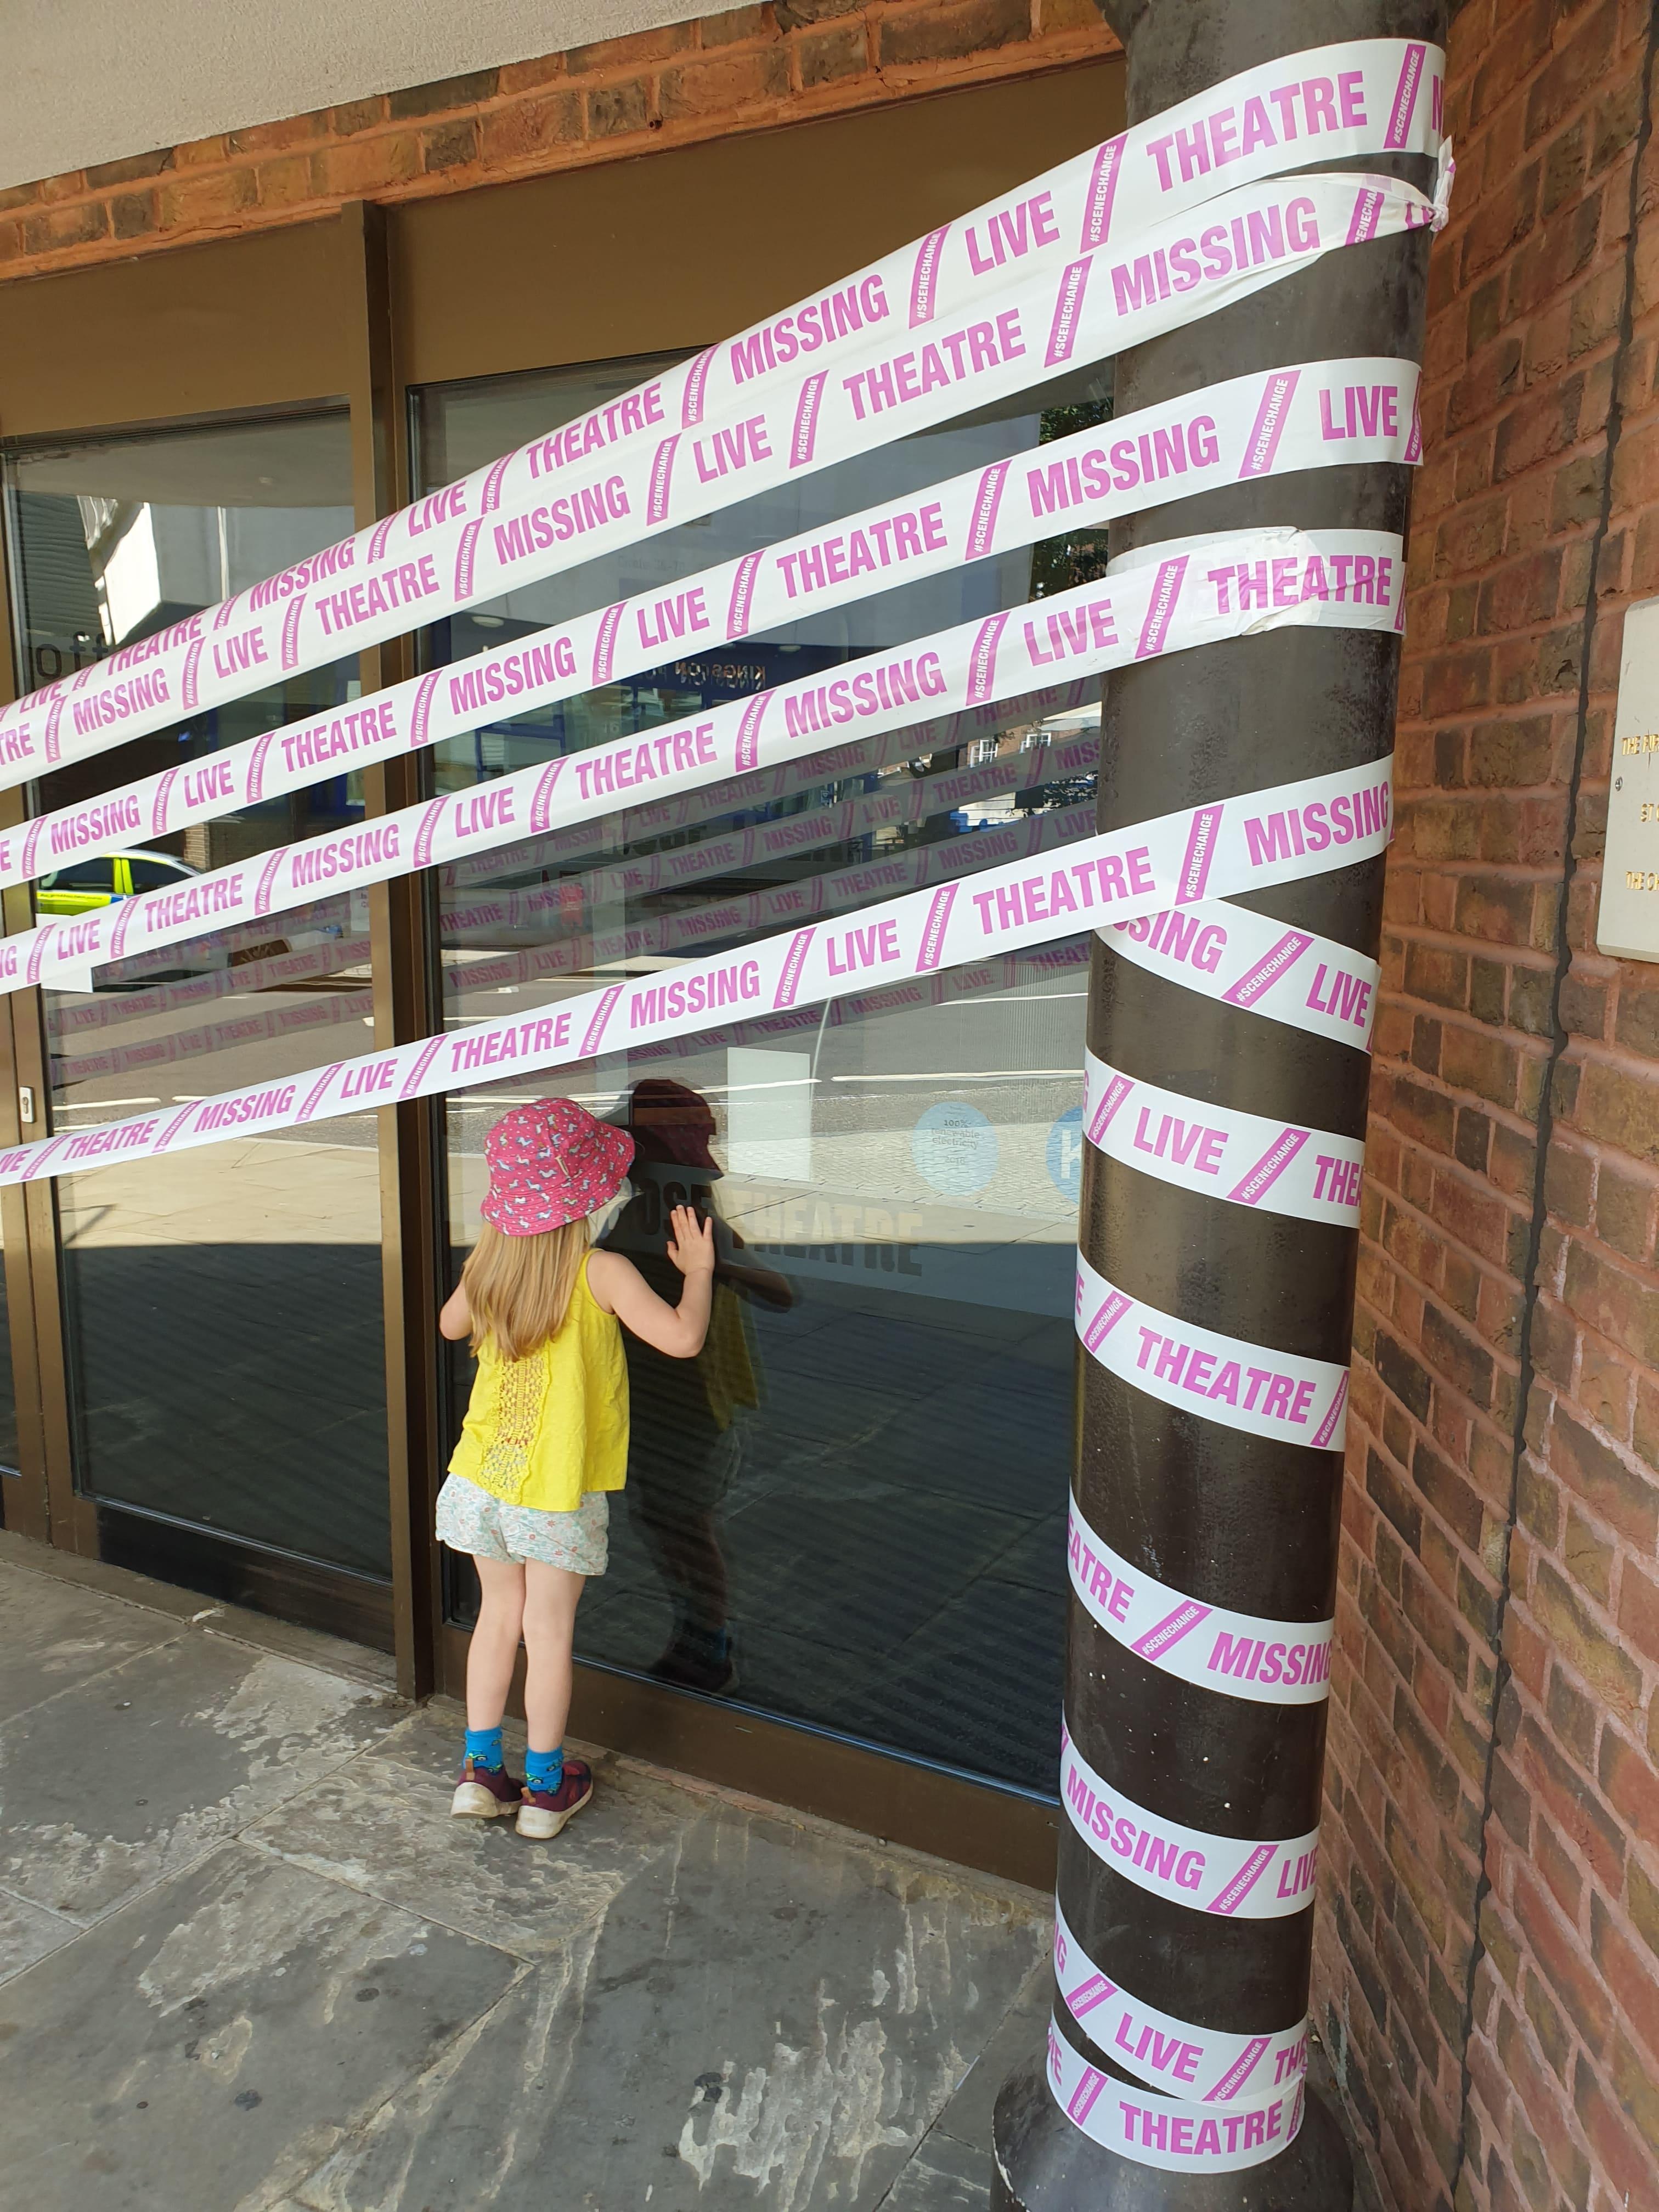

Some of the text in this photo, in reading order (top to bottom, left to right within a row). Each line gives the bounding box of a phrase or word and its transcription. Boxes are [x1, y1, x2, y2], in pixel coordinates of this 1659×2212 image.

[108, 613, 202, 676] THEATRE
[250, 537, 355, 612] MISSING
[408, 481, 466, 536] LIVE
[527, 383, 664, 479] THEATRE
[730, 275, 889, 385] MISSING
[916, 233, 940, 319] #SCENECHANGE
[965, 191, 1059, 276] LIVE
[1090, 146, 1116, 242] #SCENECHANGE
[1147, 71, 1367, 191] THEATRE
[1393, 50, 1420, 144] #SCENECHANGE
[72, 667, 170, 735] MISSING
[213, 627, 268, 678] LIVE
[315, 555, 439, 635] THEATRE
[459, 526, 476, 596] #SCENECHANGE
[493, 476, 630, 565] MISSING
[653, 442, 672, 518] #SCENECHANGE
[693, 415, 772, 483] LIVE
[797, 380, 819, 461] #SCENECHANGE
[843, 309, 1026, 421] THEATRE
[1054, 267, 1082, 358] #SCENECHANGE
[1111, 198, 1320, 316] MISSING
[50, 795, 140, 854] MISSING
[184, 761, 234, 808] LIVE
[281, 702, 396, 772] THEATRE
[415, 676, 433, 742] #SCENECHANGE
[449, 637, 576, 715] MISSING
[597, 607, 618, 680] #SCENECHANGE
[636, 588, 709, 649] LIVE
[733, 557, 755, 633] #SCENECHANGE
[776, 503, 947, 597] THEATRE
[974, 469, 1001, 553] #SCENECHANGE
[1027, 416, 1219, 518] MISSING
[1251, 379, 1288, 471] #SCENECHANGE
[1319, 386, 1398, 441] LIVE
[57, 919, 100, 960] LIVE
[145, 874, 243, 933] THEATRE
[292, 825, 399, 888] MISSING
[418, 800, 440, 862] #SCENECHANGE
[455, 787, 515, 837] LIVE
[535, 763, 558, 827] #SCENECHANGE
[575, 723, 716, 799] THEATRE
[740, 696, 765, 766] #SCENECHANGE
[784, 652, 947, 738] MISSING
[974, 620, 999, 699] #SCENECHANGE
[1023, 599, 1118, 666] LIVE
[1146, 565, 1178, 651] #SCENECHANGE
[1207, 555, 1392, 614] THEATRE
[796, 744, 865, 780] MISSING
[898, 723, 937, 750] LIVE
[1622, 736, 1641, 755] THE
[668, 842, 735, 876] THEATRE
[763, 815, 833, 852] MISSING
[934, 763, 1018, 803] THEATRE
[1054, 738, 1099, 770] MISS
[1640, 803, 1655, 822] ST
[535, 949, 569, 970] LIVE
[676, 905, 742, 937] MISSING
[832, 861, 909, 897] THEATRE
[938, 831, 1018, 870] MISSING
[1626, 871, 1645, 890] THE
[64, 1119, 158, 1160] THEATRE
[194, 1085, 296, 1132] MISSING
[340, 1059, 398, 1099] LIVE
[405, 1040, 439, 1094] #SCENECHANGE
[451, 1013, 571, 1073] THEATRE
[585, 991, 616, 1052] #SCENECHANGE
[630, 961, 760, 1029] MISSING
[780, 934, 808, 1003] #SCENECHANGE
[826, 919, 900, 976] LIVE
[924, 891, 950, 966] #SCENECHANGE
[972, 847, 1155, 934] THEATRE
[1185, 814, 1214, 898] #SCENECHANGE
[1113, 910, 1372, 1028] SING #SCENECHANGE LIVE
[931, 1127, 980, 1139] renewable
[932, 1137, 979, 1150] electricity
[1092, 1081, 1125, 1138] #SCENECHANGE
[1133, 1107, 1229, 1175] LIVE
[1240, 1134, 1299, 1200] #SCENECHANGE
[730, 1189, 922, 1277] THEATRE
[1088, 1297, 1124, 1346] #SCENECHANGE
[1137, 1327, 1316, 1425] THEATRE
[1142, 1606, 1199, 1655] #SCENECHANGE
[1066, 1765, 1205, 1891] MISSING
[1219, 1849, 1268, 1911] #SCENECHANGE
[1070, 1980, 1107, 2011] #SCENECHANGE
[1114, 2013, 1203, 2083] LIVE
[1073, 2073, 1099, 2119] #SCENECHANGE
[1119, 2100, 1282, 2155] THEATRE
